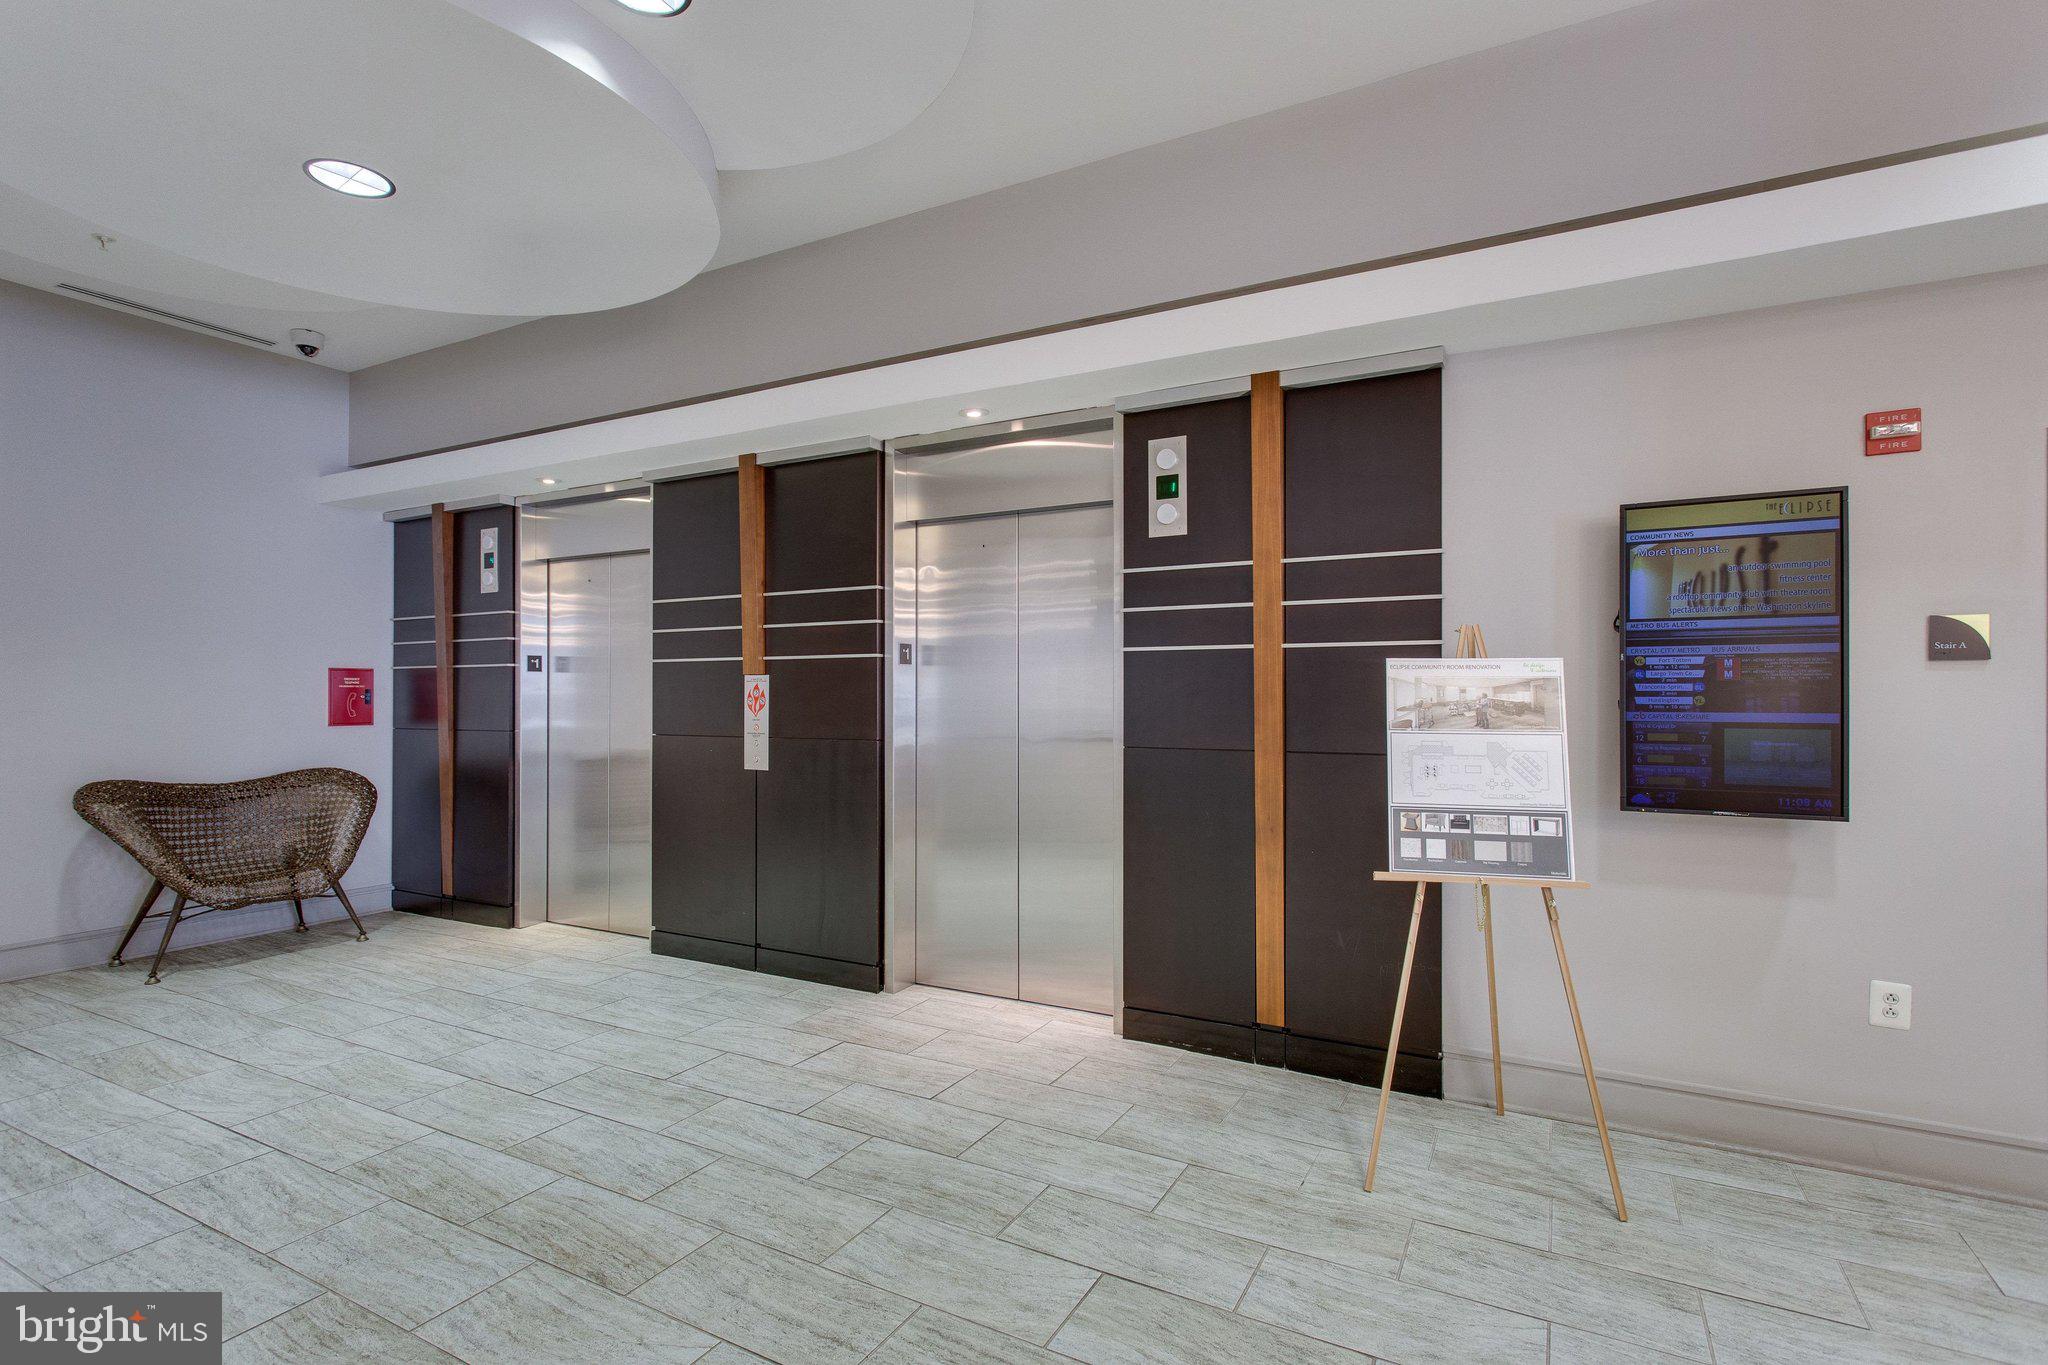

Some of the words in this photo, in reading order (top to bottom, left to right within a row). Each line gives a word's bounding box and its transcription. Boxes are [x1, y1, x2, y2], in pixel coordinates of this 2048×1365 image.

[1880, 414, 1908, 422] FIRE
[1880, 441, 1909, 449] FIRE
[1779, 500, 1832, 515] ECLIPSE
[1630, 533, 1671, 541] COMMUNITY
[1638, 549, 1666, 557] More
[1670, 546, 1695, 556] than
[1698, 544, 1729, 556] just...
[1771, 560, 1811, 569] swimming
[1814, 559, 1831, 568] pool
[1673, 593, 1699, 601] rooftop
[1701, 592, 1741, 600] community
[1669, 606, 1709, 615] spectacular
[1757, 603, 1801, 611] Washington
[1803, 601, 1831, 610] skyline
[1934, 641, 1957, 649] Stair
